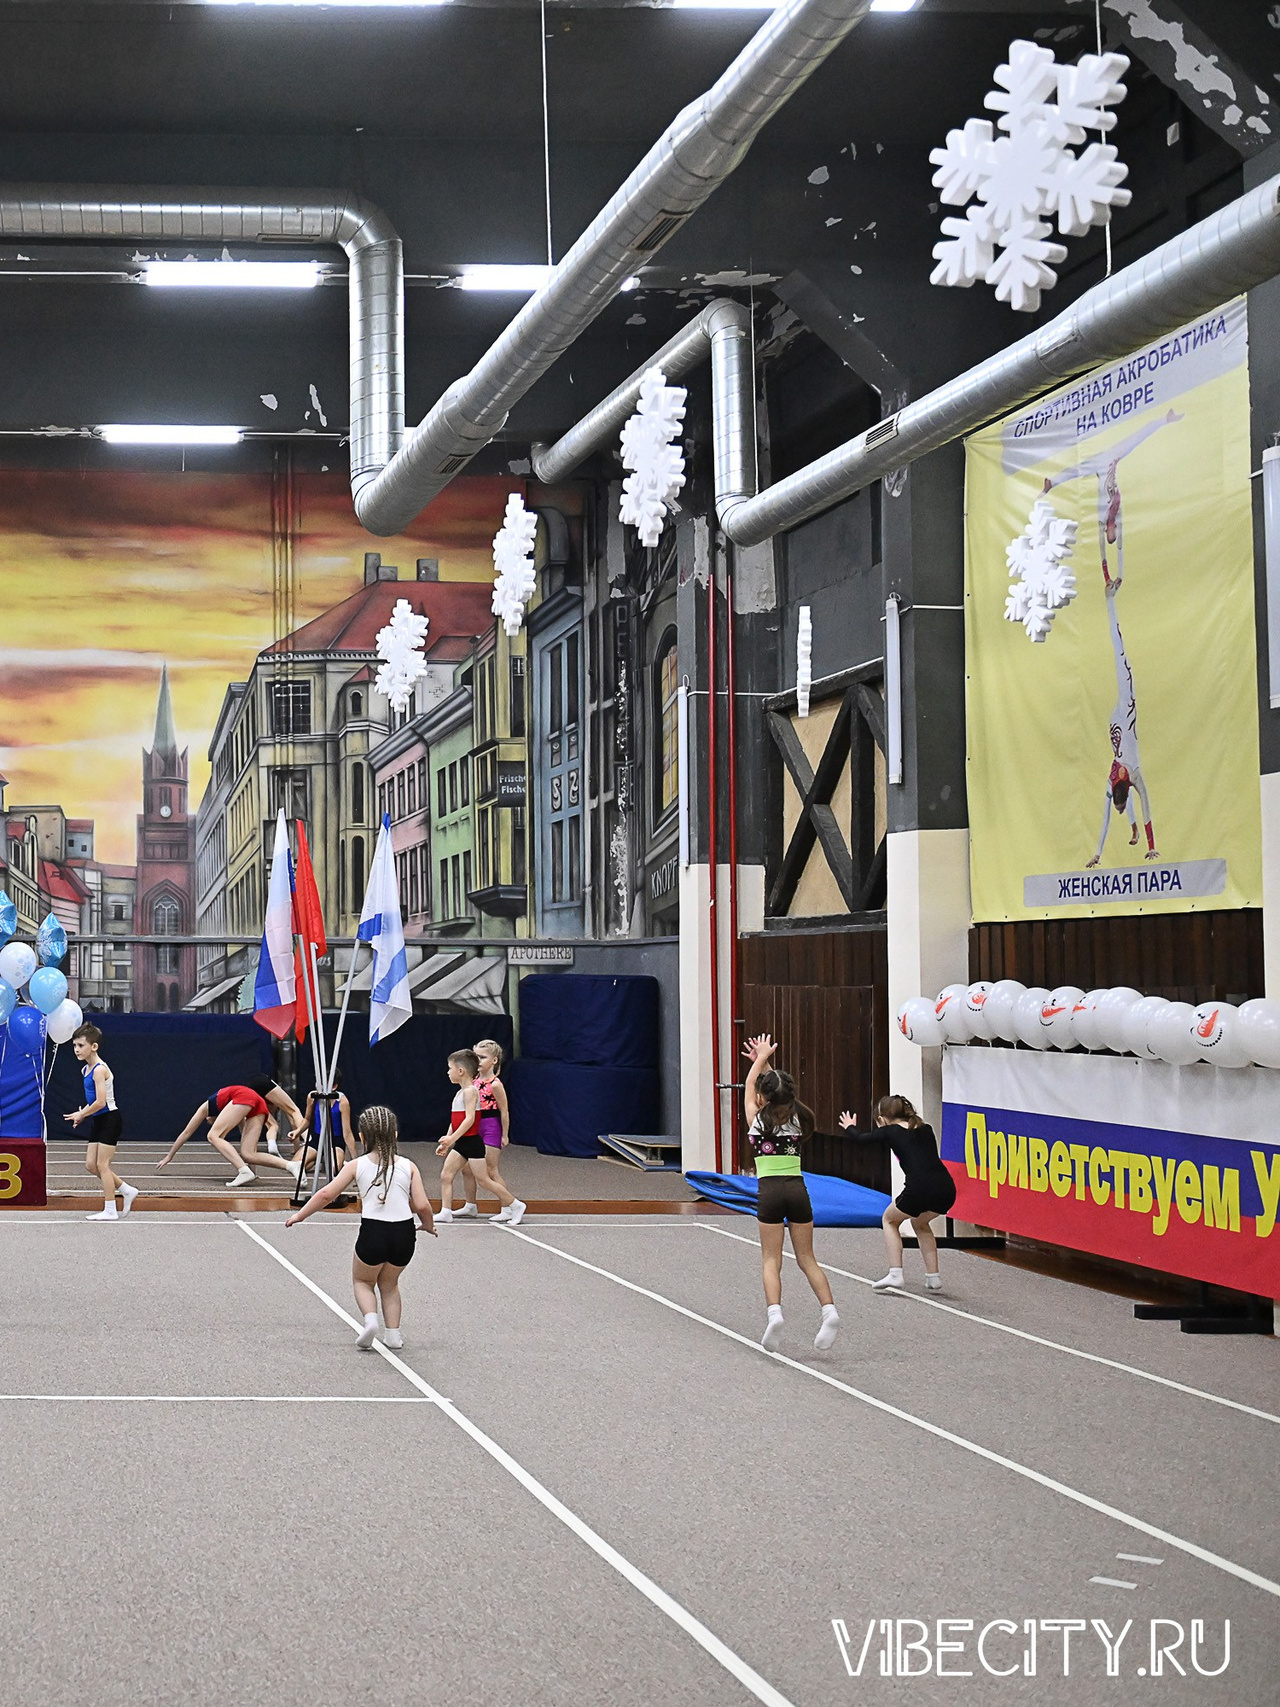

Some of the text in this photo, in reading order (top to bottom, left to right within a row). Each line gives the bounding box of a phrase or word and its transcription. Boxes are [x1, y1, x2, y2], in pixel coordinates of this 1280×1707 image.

[1013, 315, 1227, 438] СПОРТИВНАЯ АКРОБАТИКА
[1076, 382, 1154, 436] НА КОВРЕ
[1058, 869, 1182, 898] ЖЕНСКАЯ ПАРА
[965, 1111, 1241, 1236] Приветствуем
